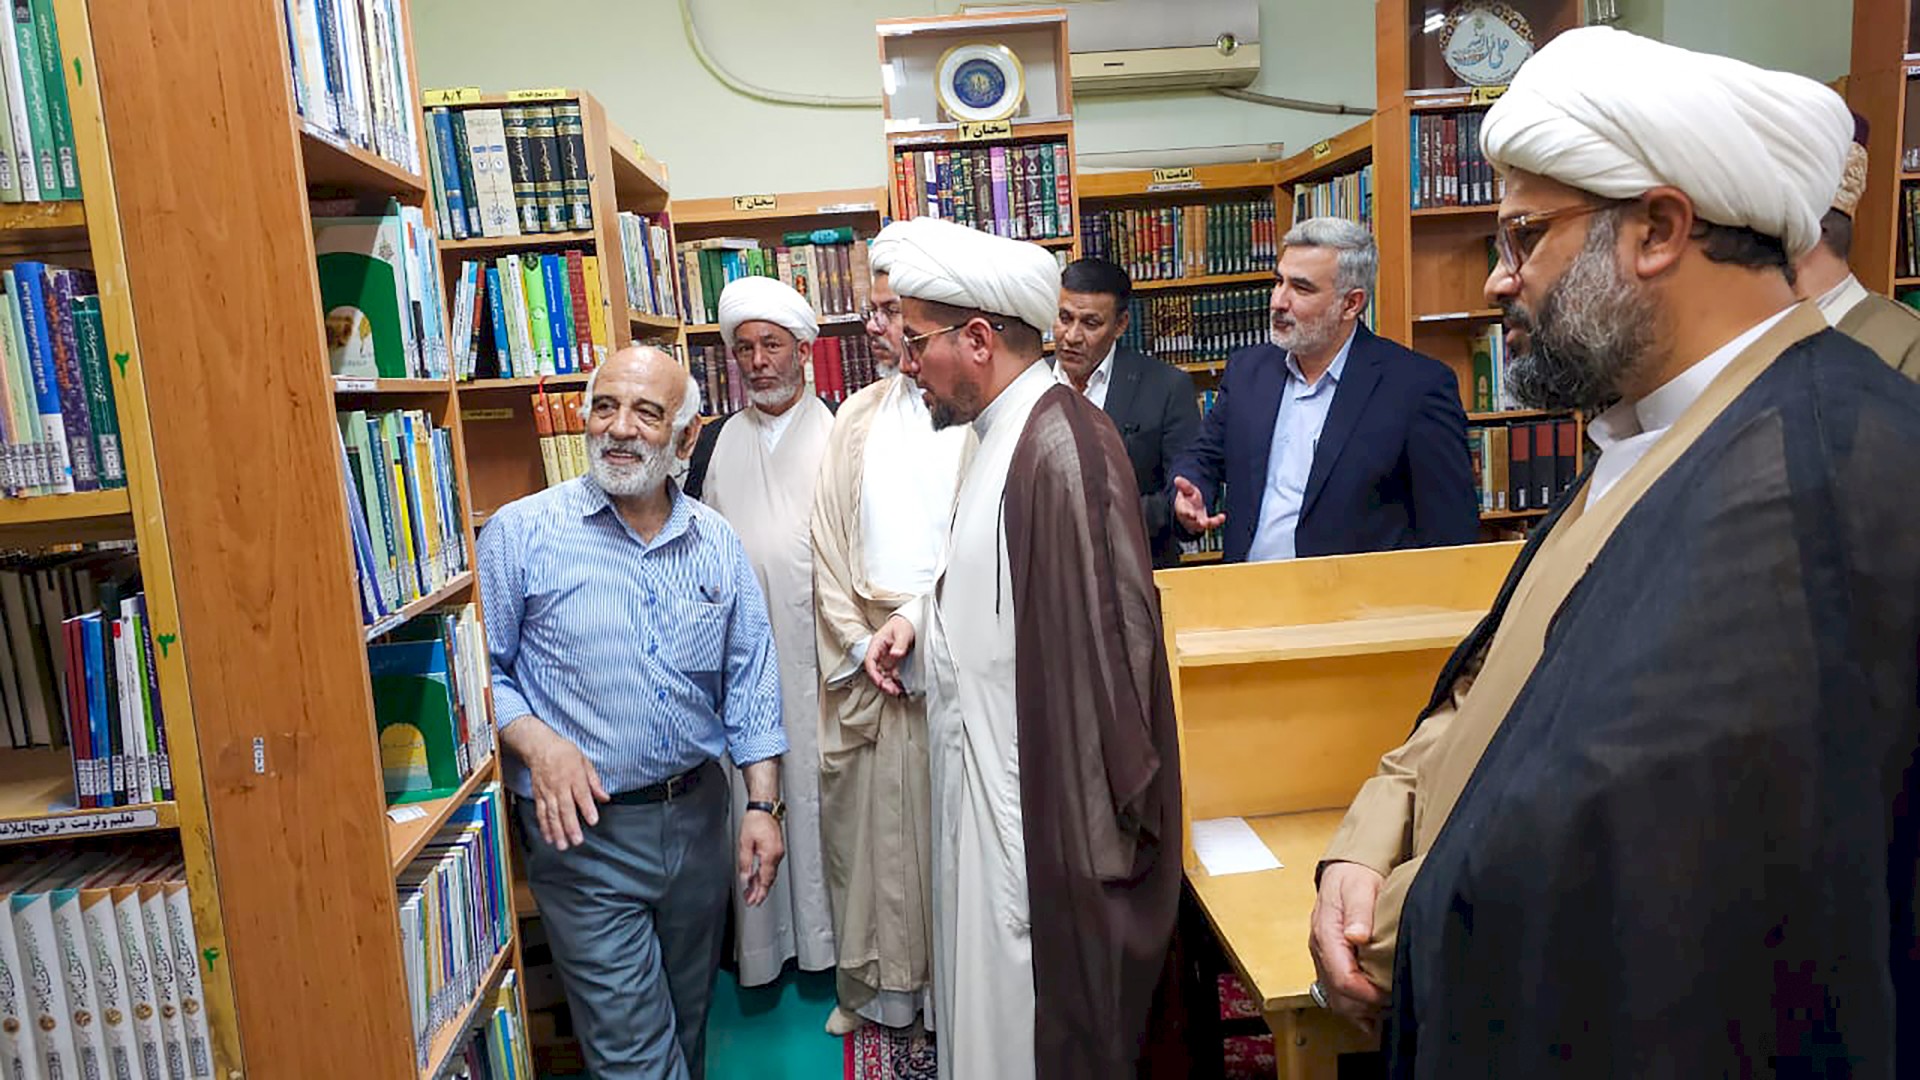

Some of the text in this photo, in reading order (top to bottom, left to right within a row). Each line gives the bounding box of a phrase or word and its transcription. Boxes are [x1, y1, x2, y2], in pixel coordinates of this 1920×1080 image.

[973, 123, 1008, 139] سخنان
[746, 197, 774, 209] سخنان
[54, 820, 66, 833] در
[110, 812, 135, 828] تعلیم
